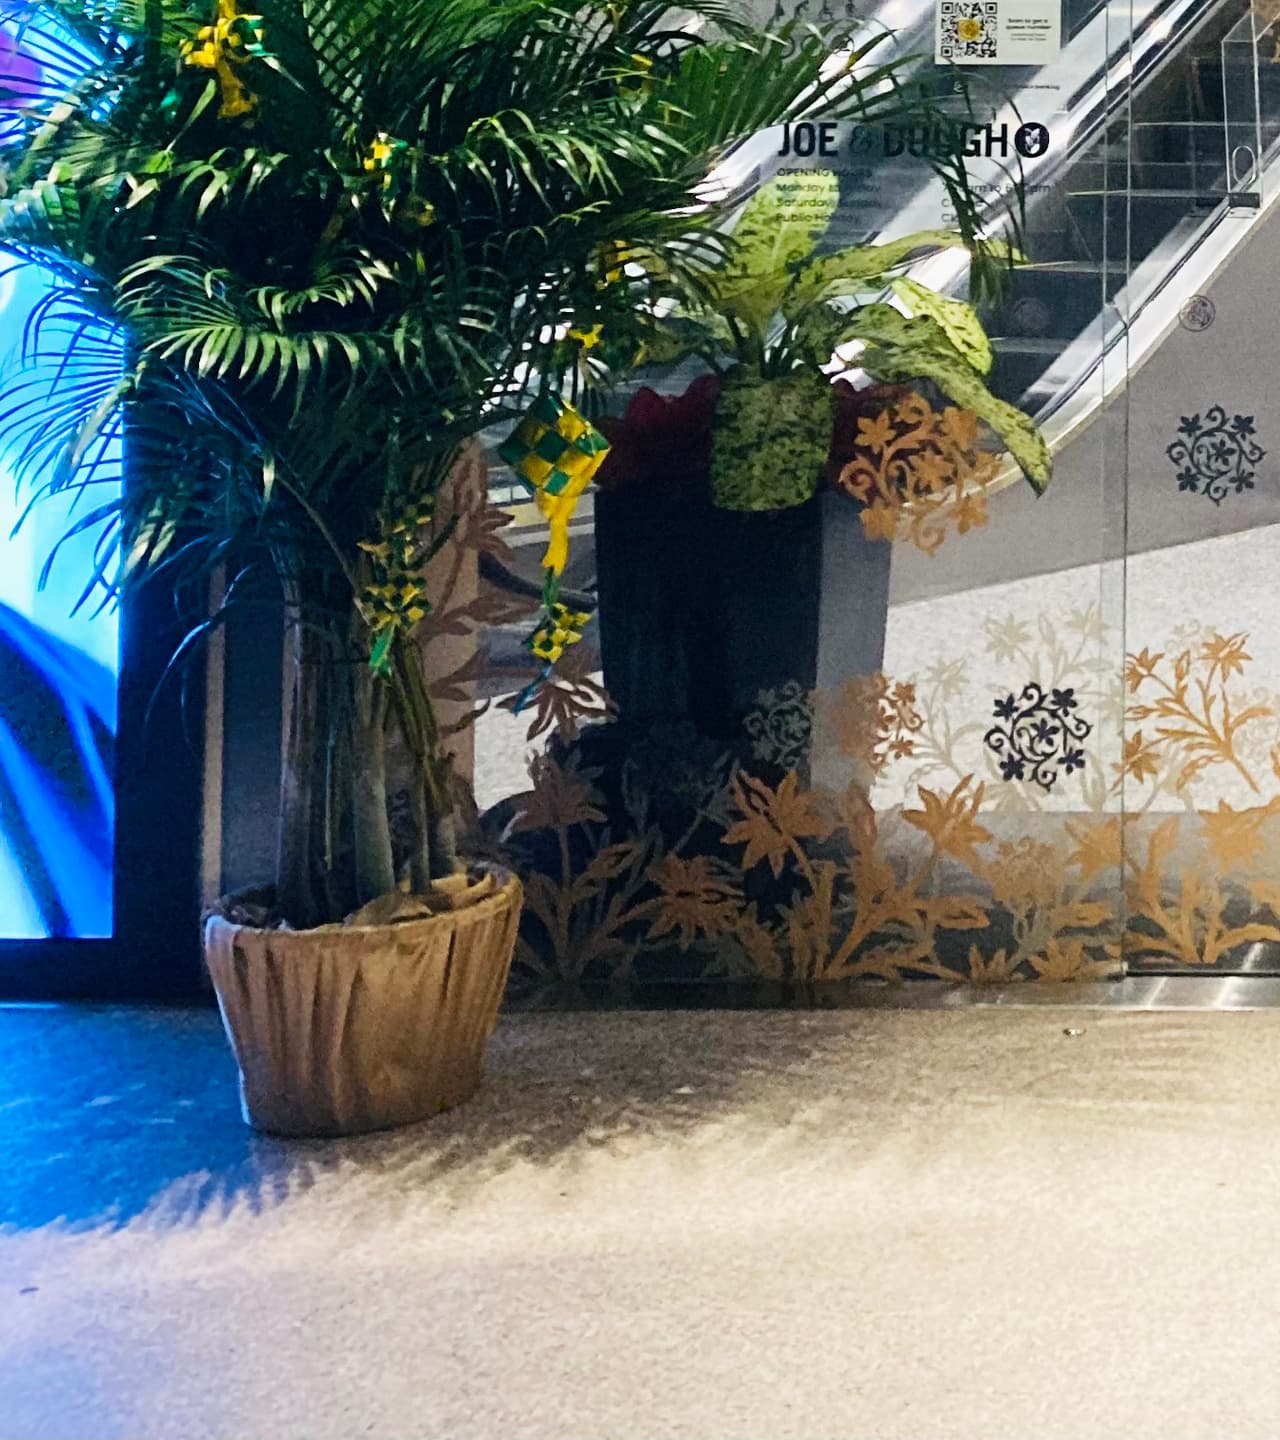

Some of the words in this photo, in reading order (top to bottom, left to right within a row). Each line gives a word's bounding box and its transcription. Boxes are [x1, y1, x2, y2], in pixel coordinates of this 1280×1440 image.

[777, 121, 839, 158] JOE
[775, 166, 829, 177] OPENING
[775, 184, 826, 194] Monday
[775, 212, 814, 223] Public
